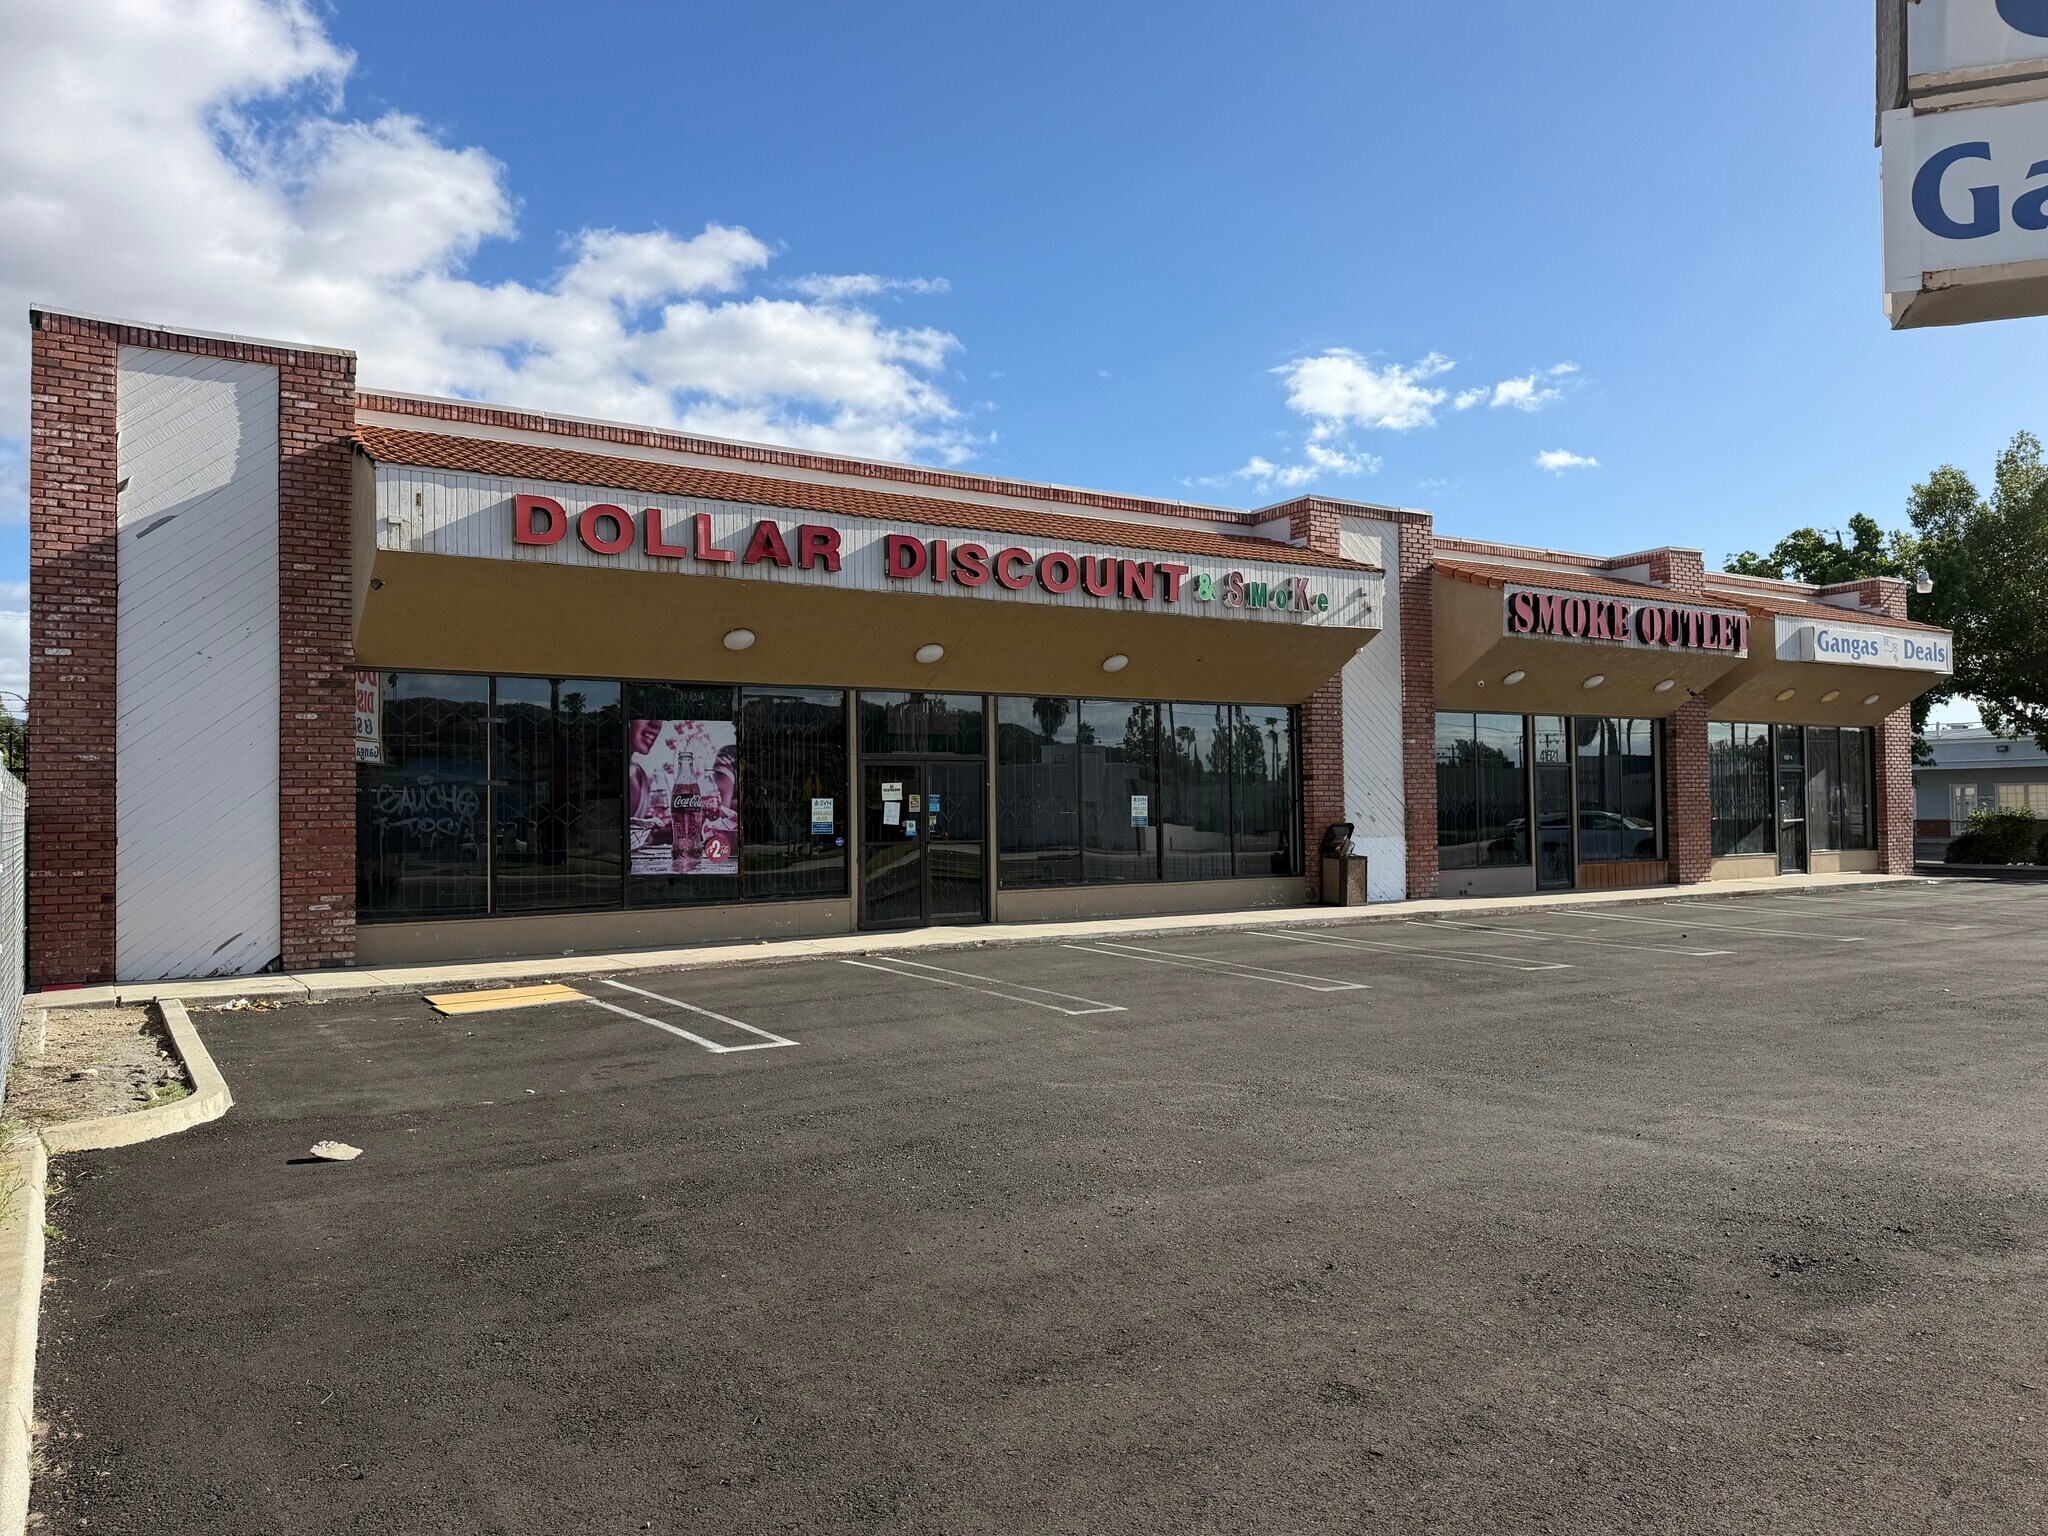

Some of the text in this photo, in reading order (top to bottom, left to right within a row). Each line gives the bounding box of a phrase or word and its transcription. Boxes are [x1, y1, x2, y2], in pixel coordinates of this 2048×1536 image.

[514, 494, 842, 572] DOLLAR
[885, 534, 1190, 602] DISCOUNT
[1194, 573, 1216, 602] &
[1508, 591, 1750, 651] SMOKE OUTLET
[1817, 630, 1879, 660] Gangas
[1904, 639, 1946, 663] Deals
